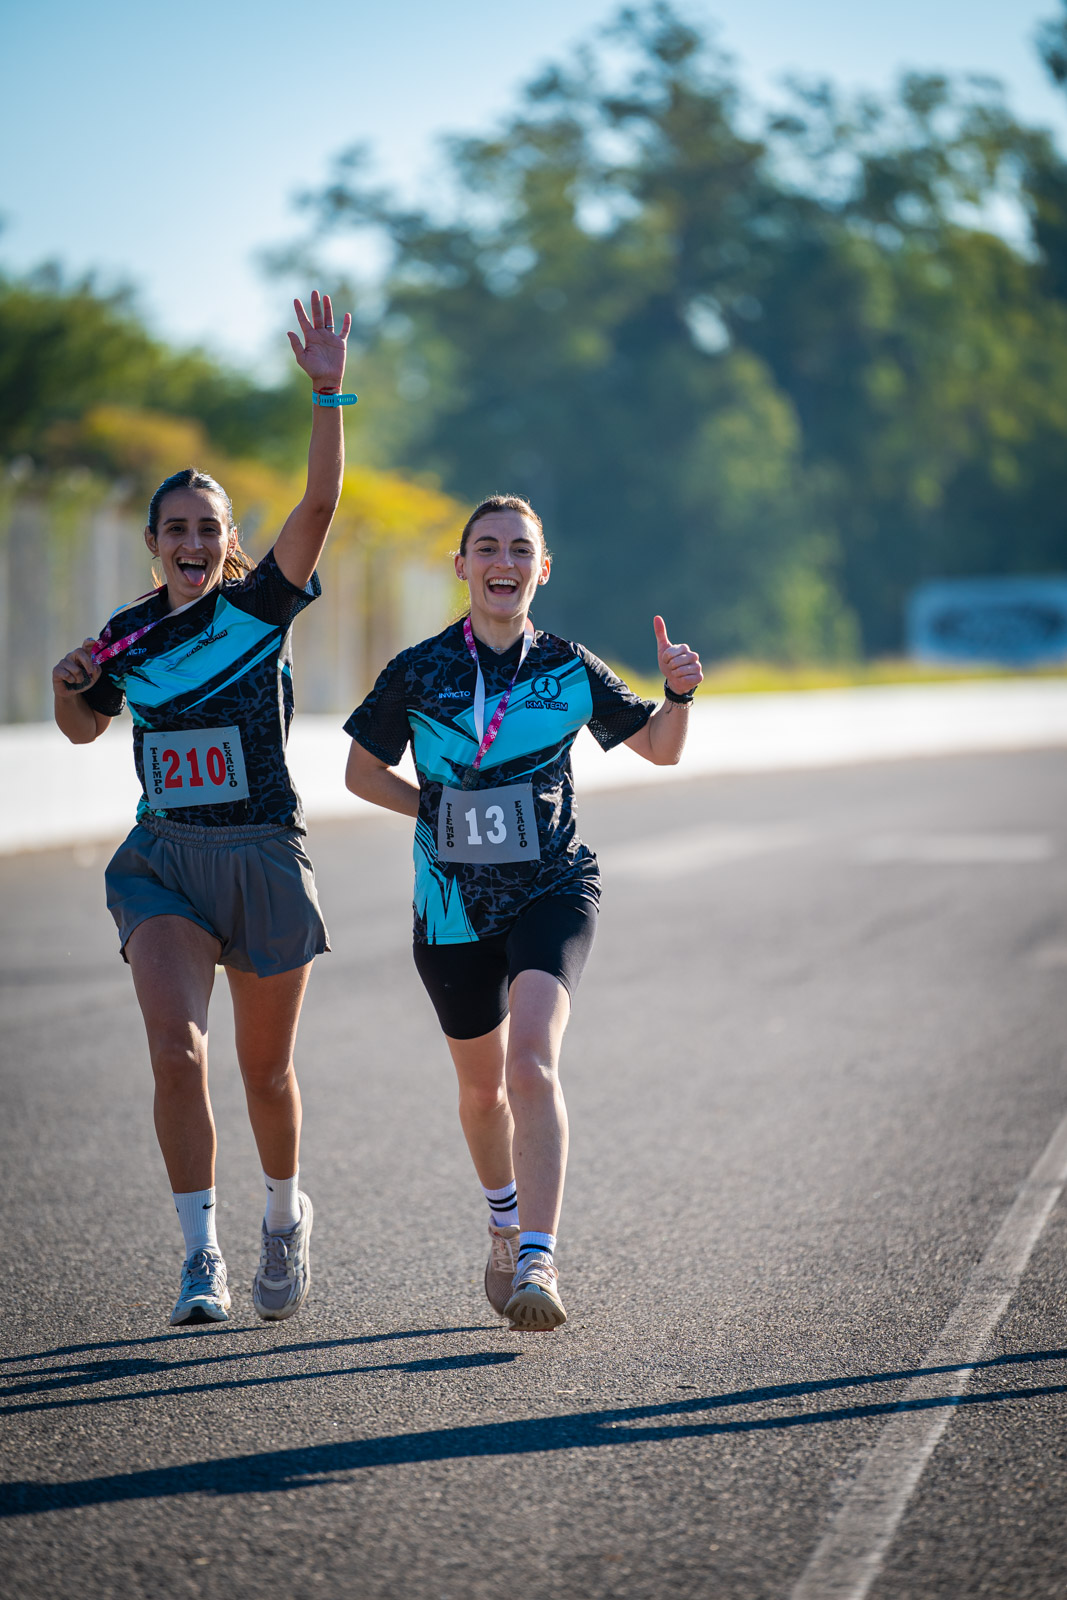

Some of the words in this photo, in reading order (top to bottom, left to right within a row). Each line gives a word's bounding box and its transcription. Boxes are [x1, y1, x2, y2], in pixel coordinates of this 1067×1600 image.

[438, 690, 471, 699] INVICTO
[543, 701, 568, 712] TEAM
[150, 747, 163, 795] TIEMPO
[162, 746, 226, 789] 210
[222, 742, 238, 788] EXACTO
[446, 802, 455, 848] TIEMPO
[465, 805, 507, 845] 13
[514, 800, 528, 848] EXACTO
